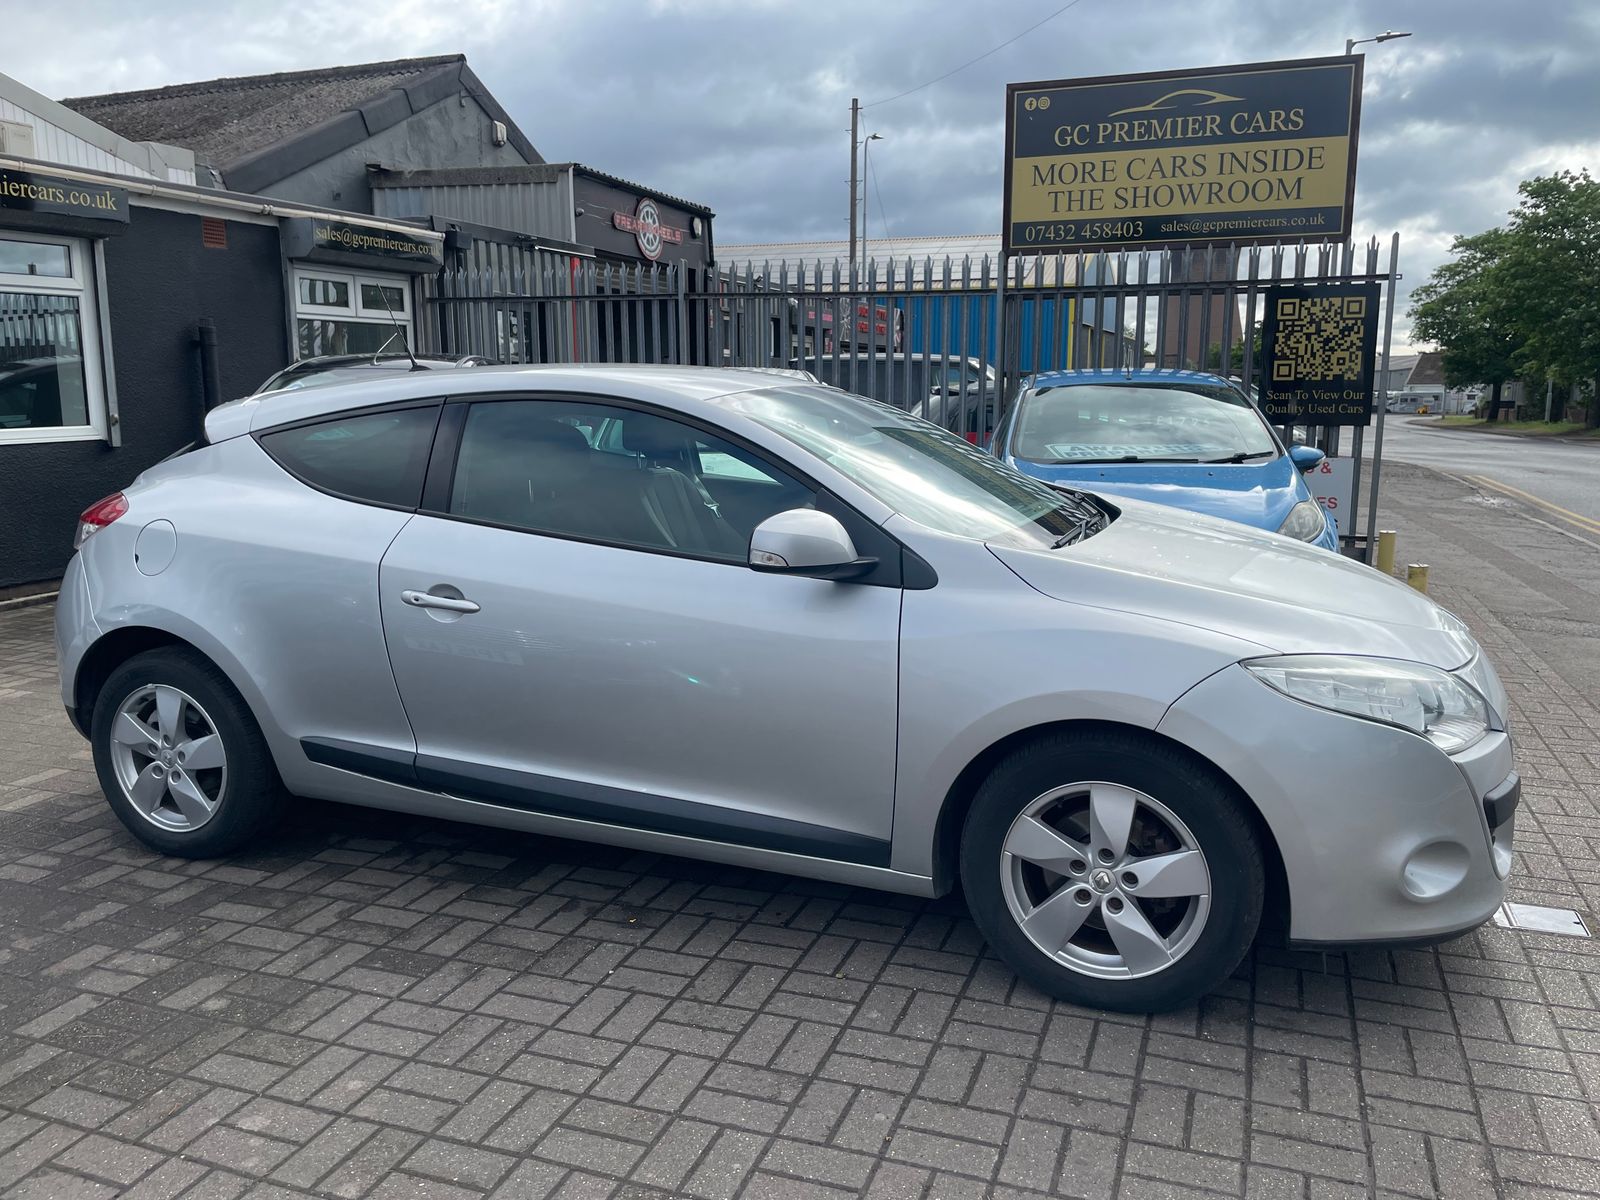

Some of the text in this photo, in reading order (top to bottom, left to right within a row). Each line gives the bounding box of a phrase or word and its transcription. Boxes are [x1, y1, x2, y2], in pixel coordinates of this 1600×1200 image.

[1054, 108, 1304, 147] GC PREMIER CARS
[1032, 146, 1325, 187] MORE CARS INSIDE
[0, 174, 118, 210] iercars.co.uk
[1048, 176, 1304, 213] THE SHOWROOM
[315, 225, 441, 256] sales@gcpremiercars.co.uk
[1025, 213, 1325, 242] 07432 458403 sales@gcpremiercars.co.uk
[1265, 403, 1364, 416] Quality Used Cars
[1266, 389, 1365, 400] Scan To View Our
[1320, 461, 1332, 474] &
